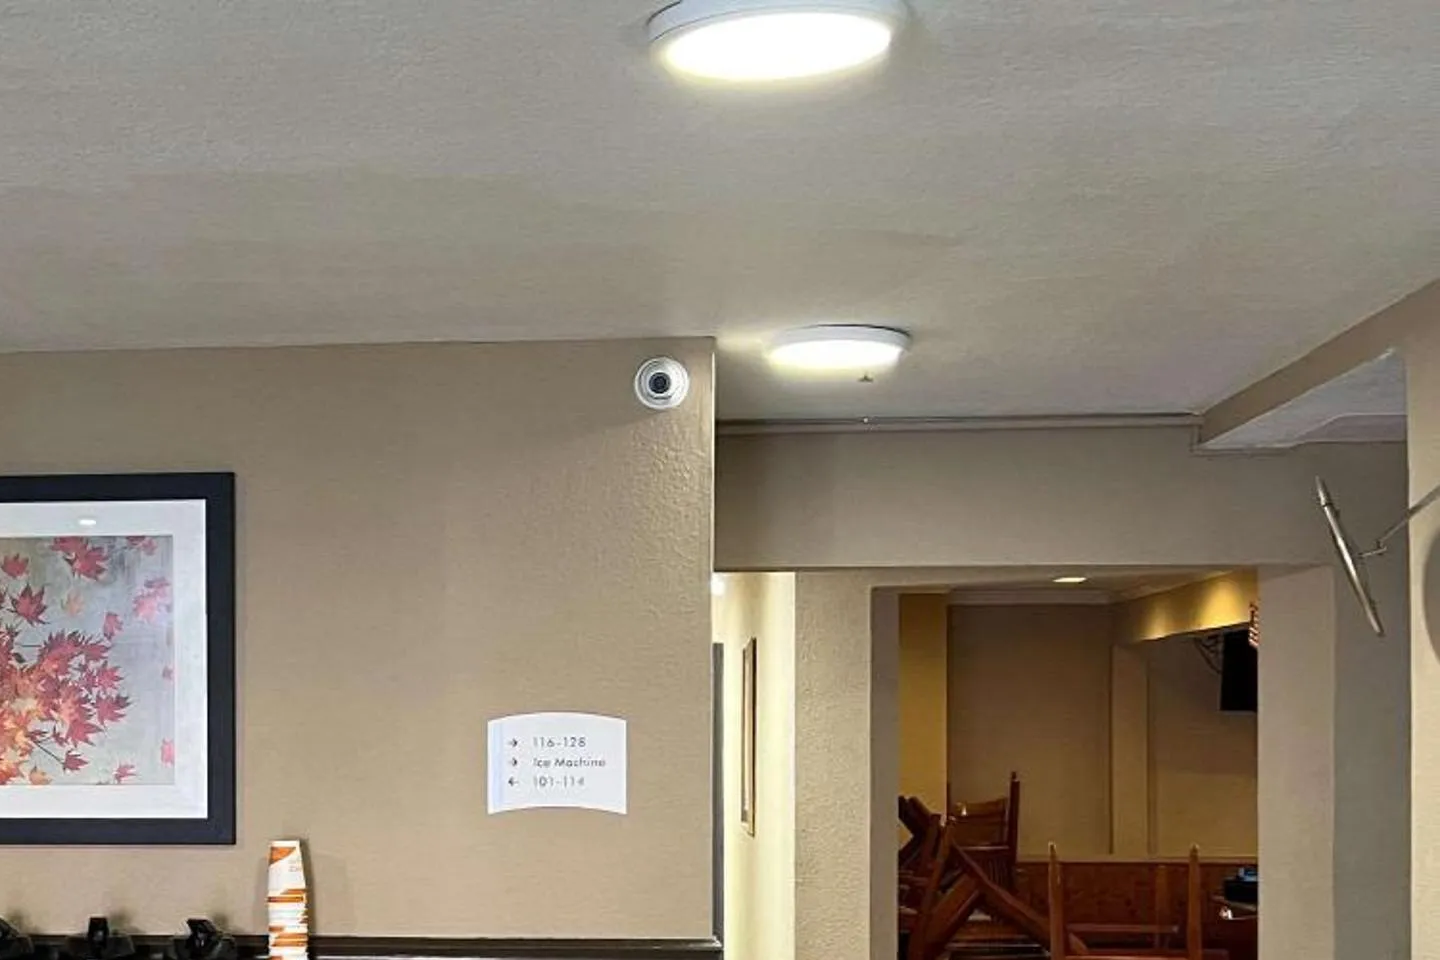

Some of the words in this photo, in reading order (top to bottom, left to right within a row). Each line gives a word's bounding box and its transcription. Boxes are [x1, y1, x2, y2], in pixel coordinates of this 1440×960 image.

[532, 736, 586, 748] 116-128
[532, 758, 552, 767] Ice
[554, 756, 607, 767] Machine
[532, 775, 585, 788] 101-114
